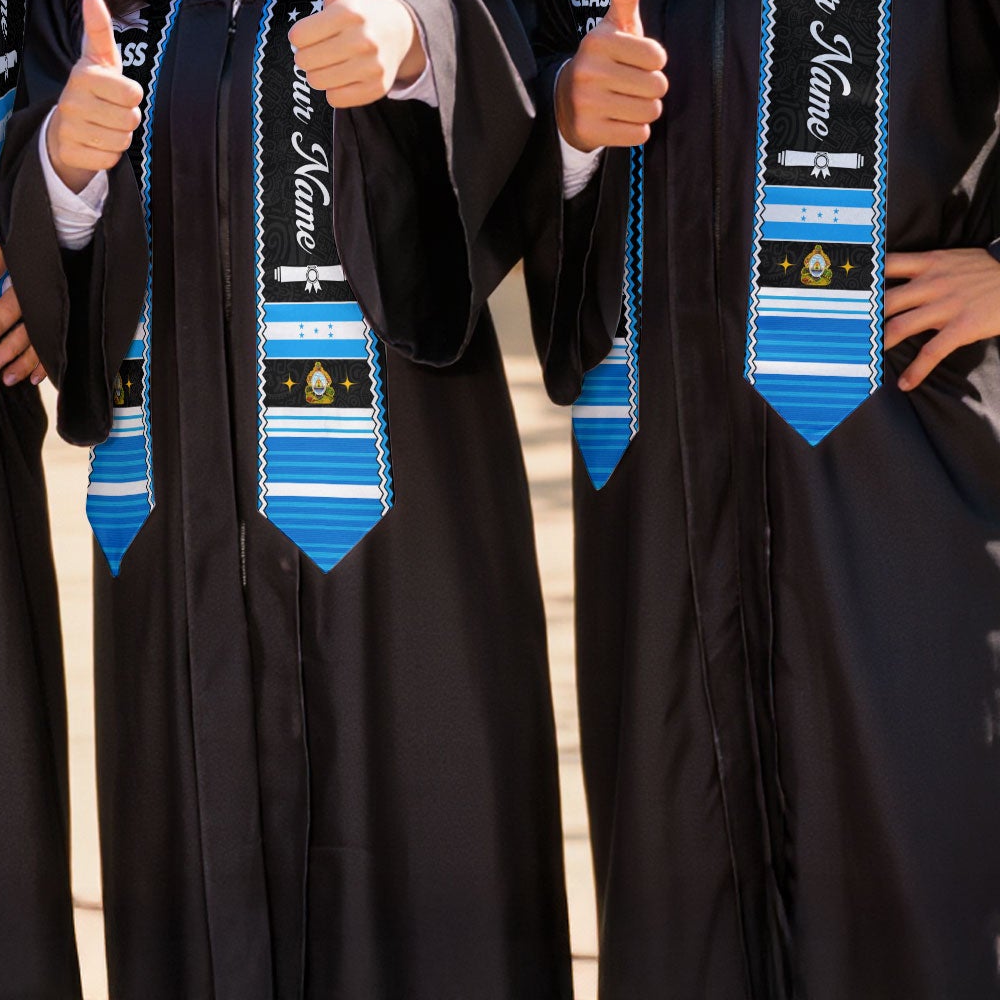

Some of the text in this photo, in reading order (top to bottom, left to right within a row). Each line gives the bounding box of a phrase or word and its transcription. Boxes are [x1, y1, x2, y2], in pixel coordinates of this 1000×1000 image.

[290, 44, 331, 255] our Name
[806, 20, 853, 142] Name
